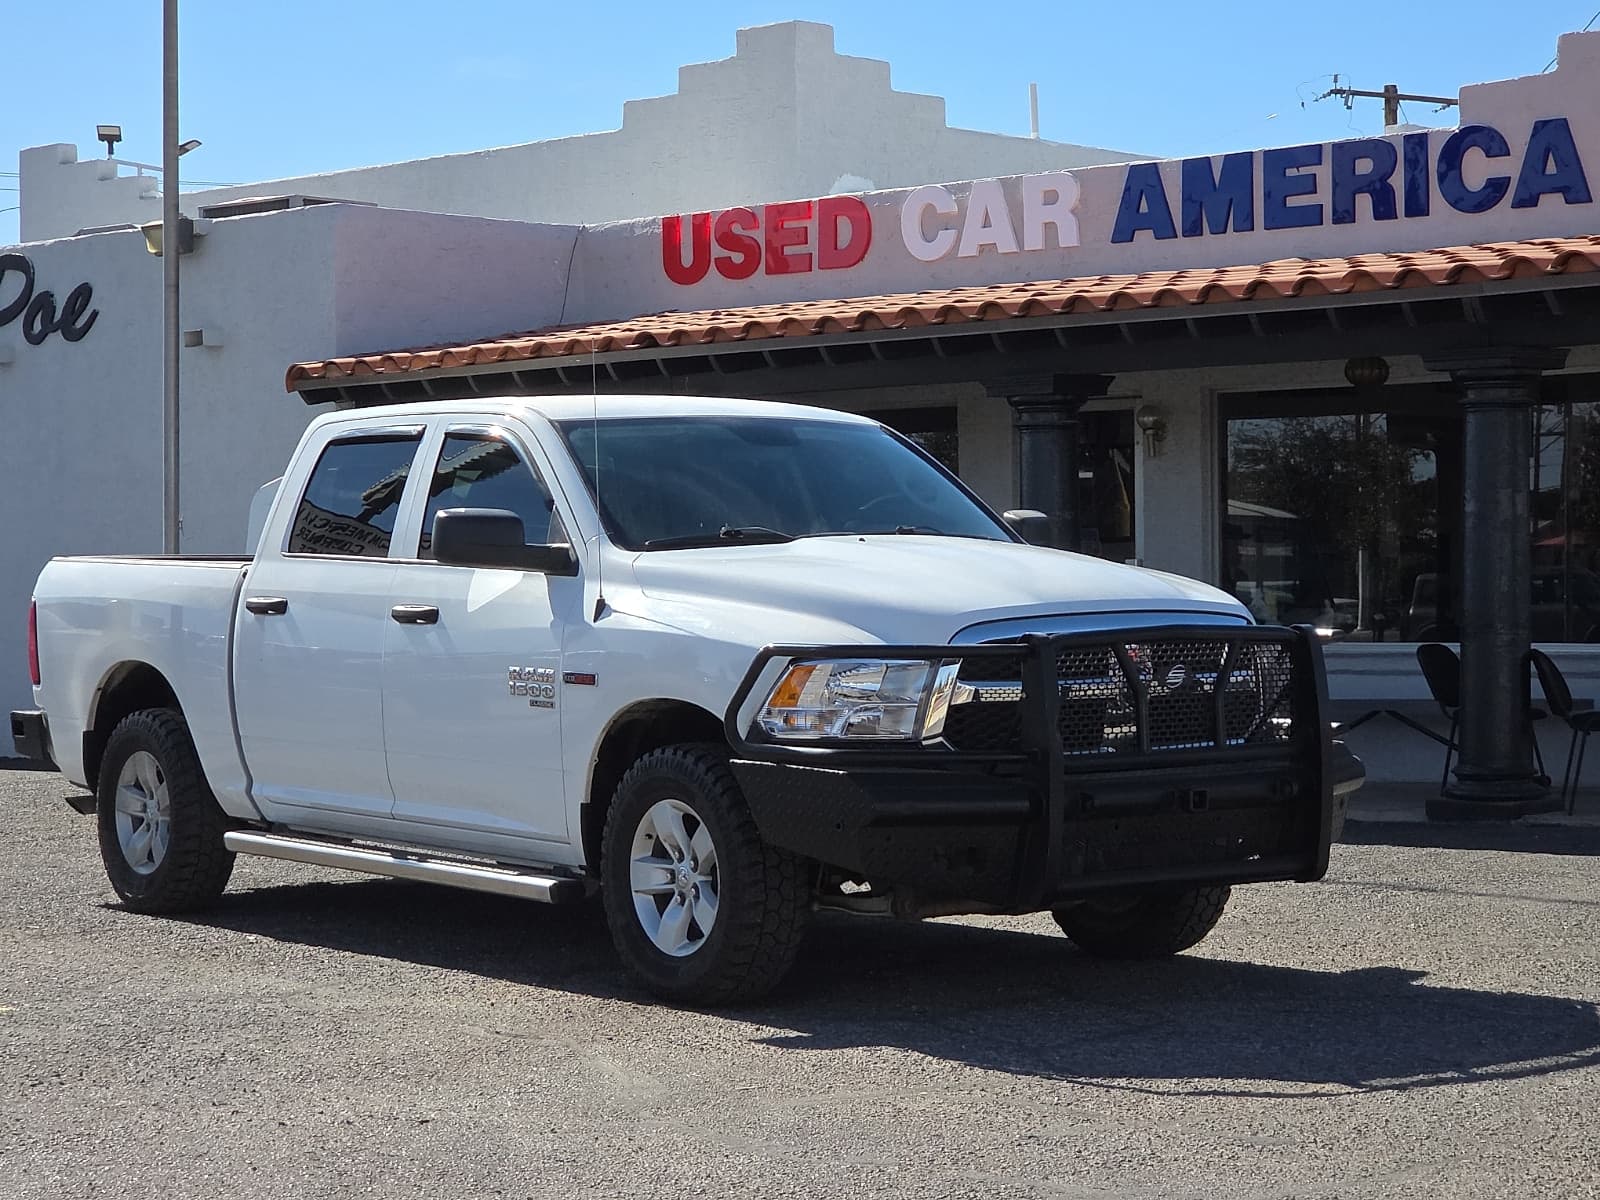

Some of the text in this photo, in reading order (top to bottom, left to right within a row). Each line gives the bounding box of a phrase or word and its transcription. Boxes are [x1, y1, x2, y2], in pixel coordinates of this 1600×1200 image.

[662, 117, 1593, 286] USED CAR AMERICA
[508, 681, 556, 699] 1500
